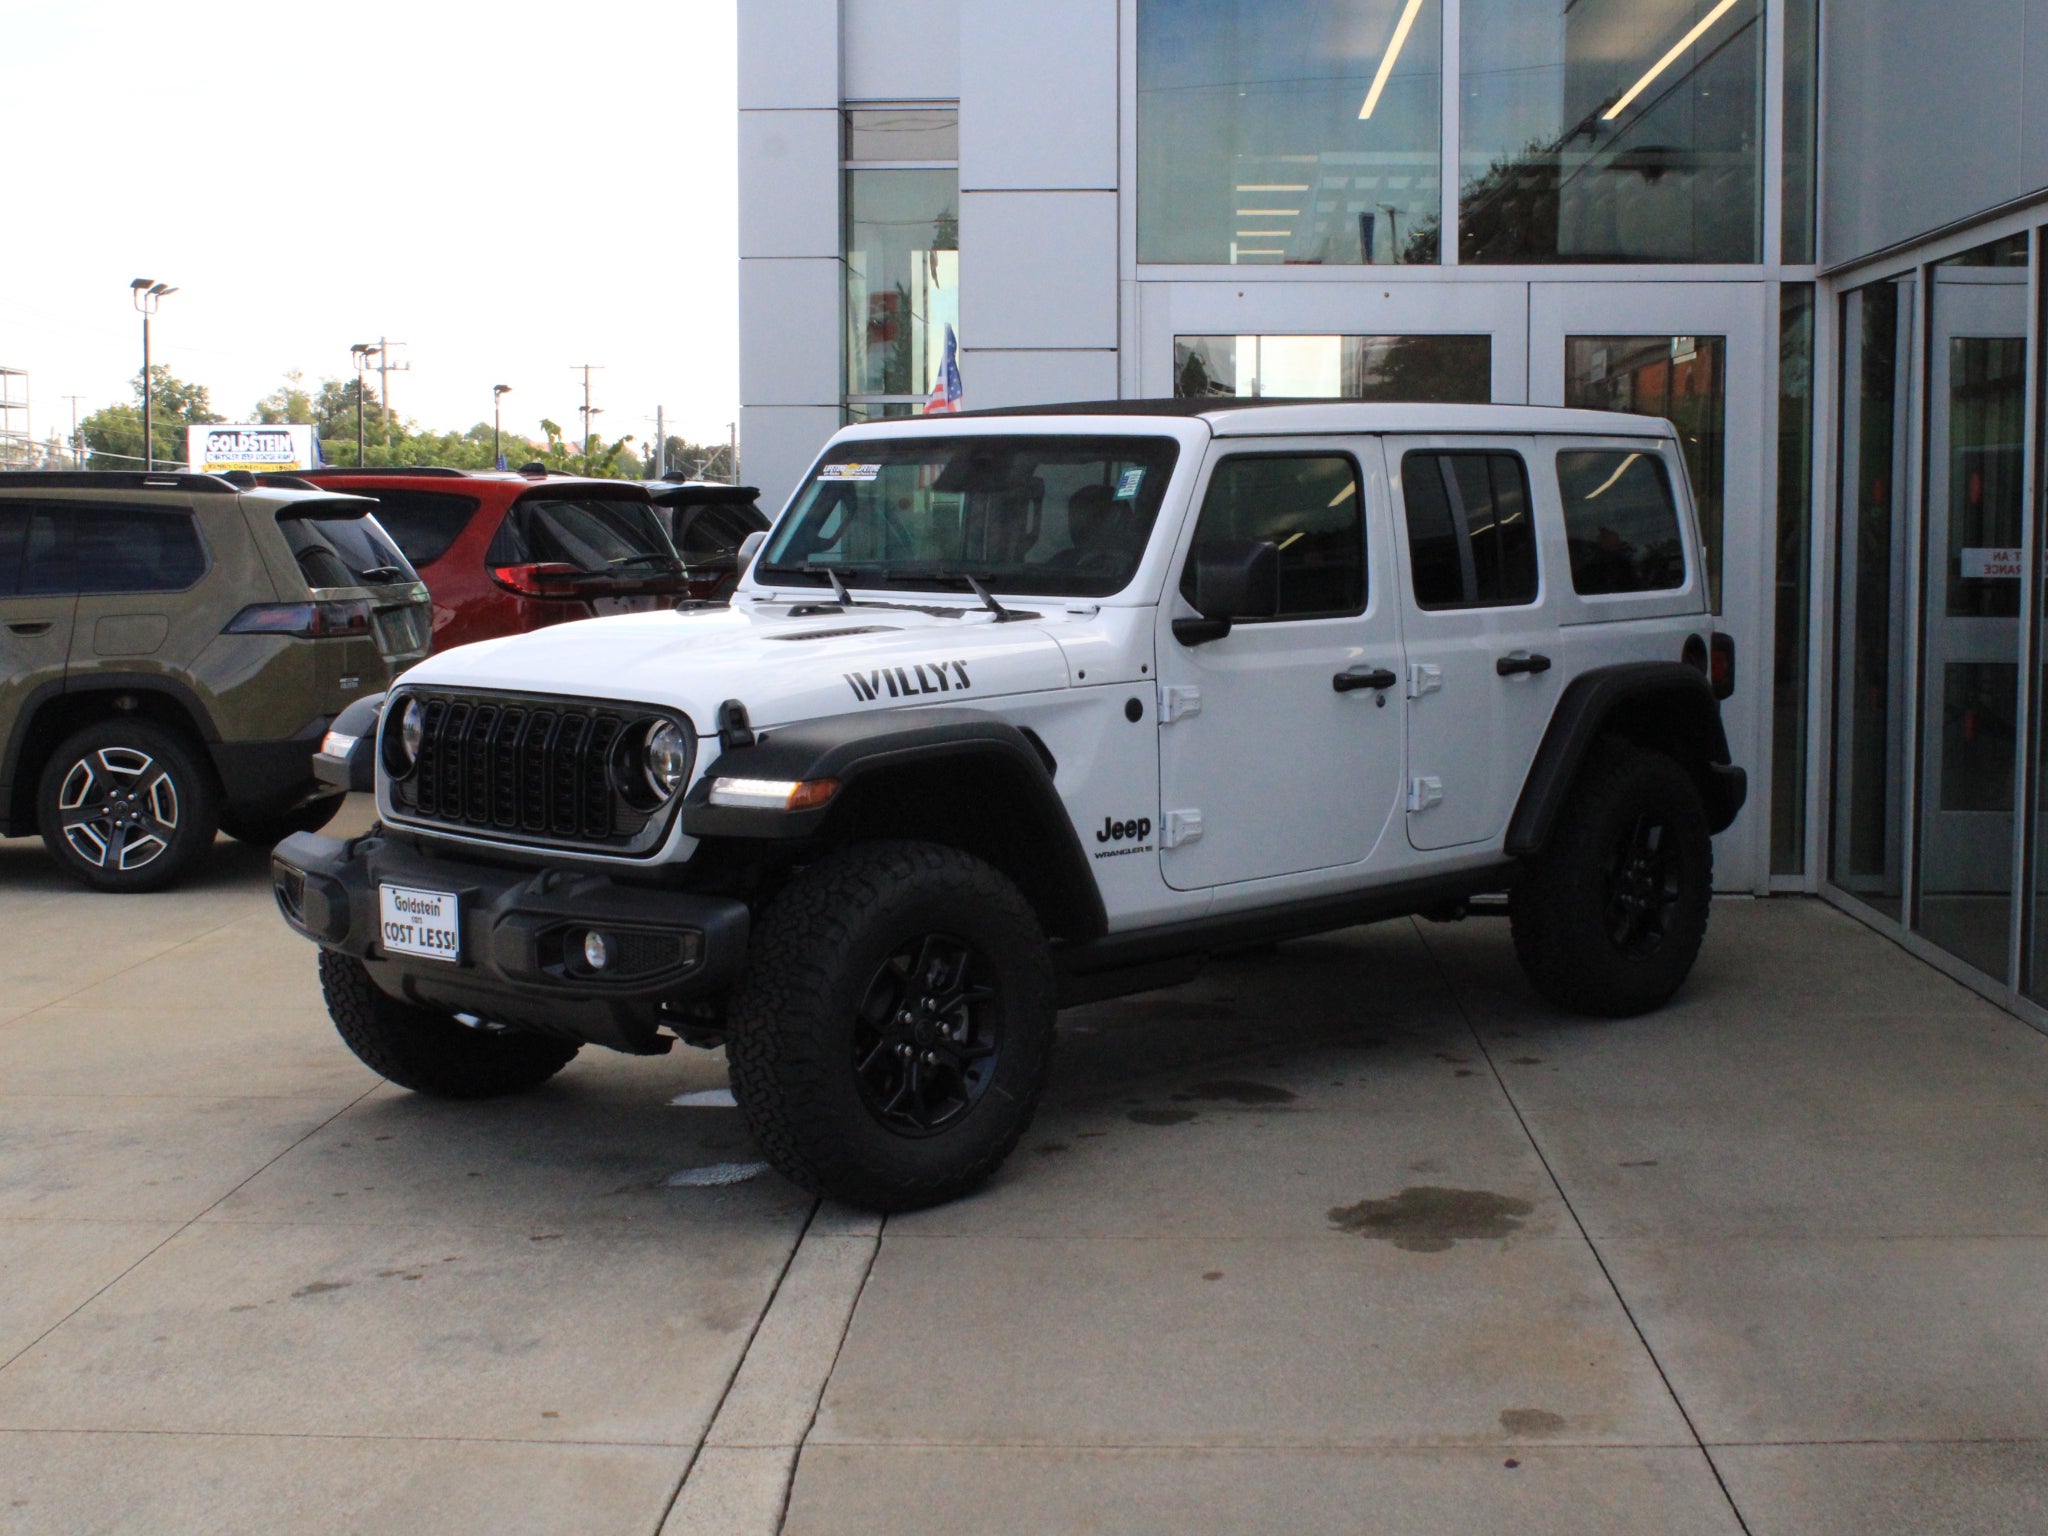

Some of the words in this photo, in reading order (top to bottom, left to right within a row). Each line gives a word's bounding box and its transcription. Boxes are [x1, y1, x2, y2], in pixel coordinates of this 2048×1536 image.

[207, 434, 291, 452] GOLDSTEIN
[843, 660, 970, 701] WILLYS
[1097, 816, 1151, 842] Jeep
[1095, 847, 1143, 859] WRANGLER
[395, 896, 440, 917] Goldstein
[384, 921, 414, 944] COST
[419, 927, 456, 950] LESS!
